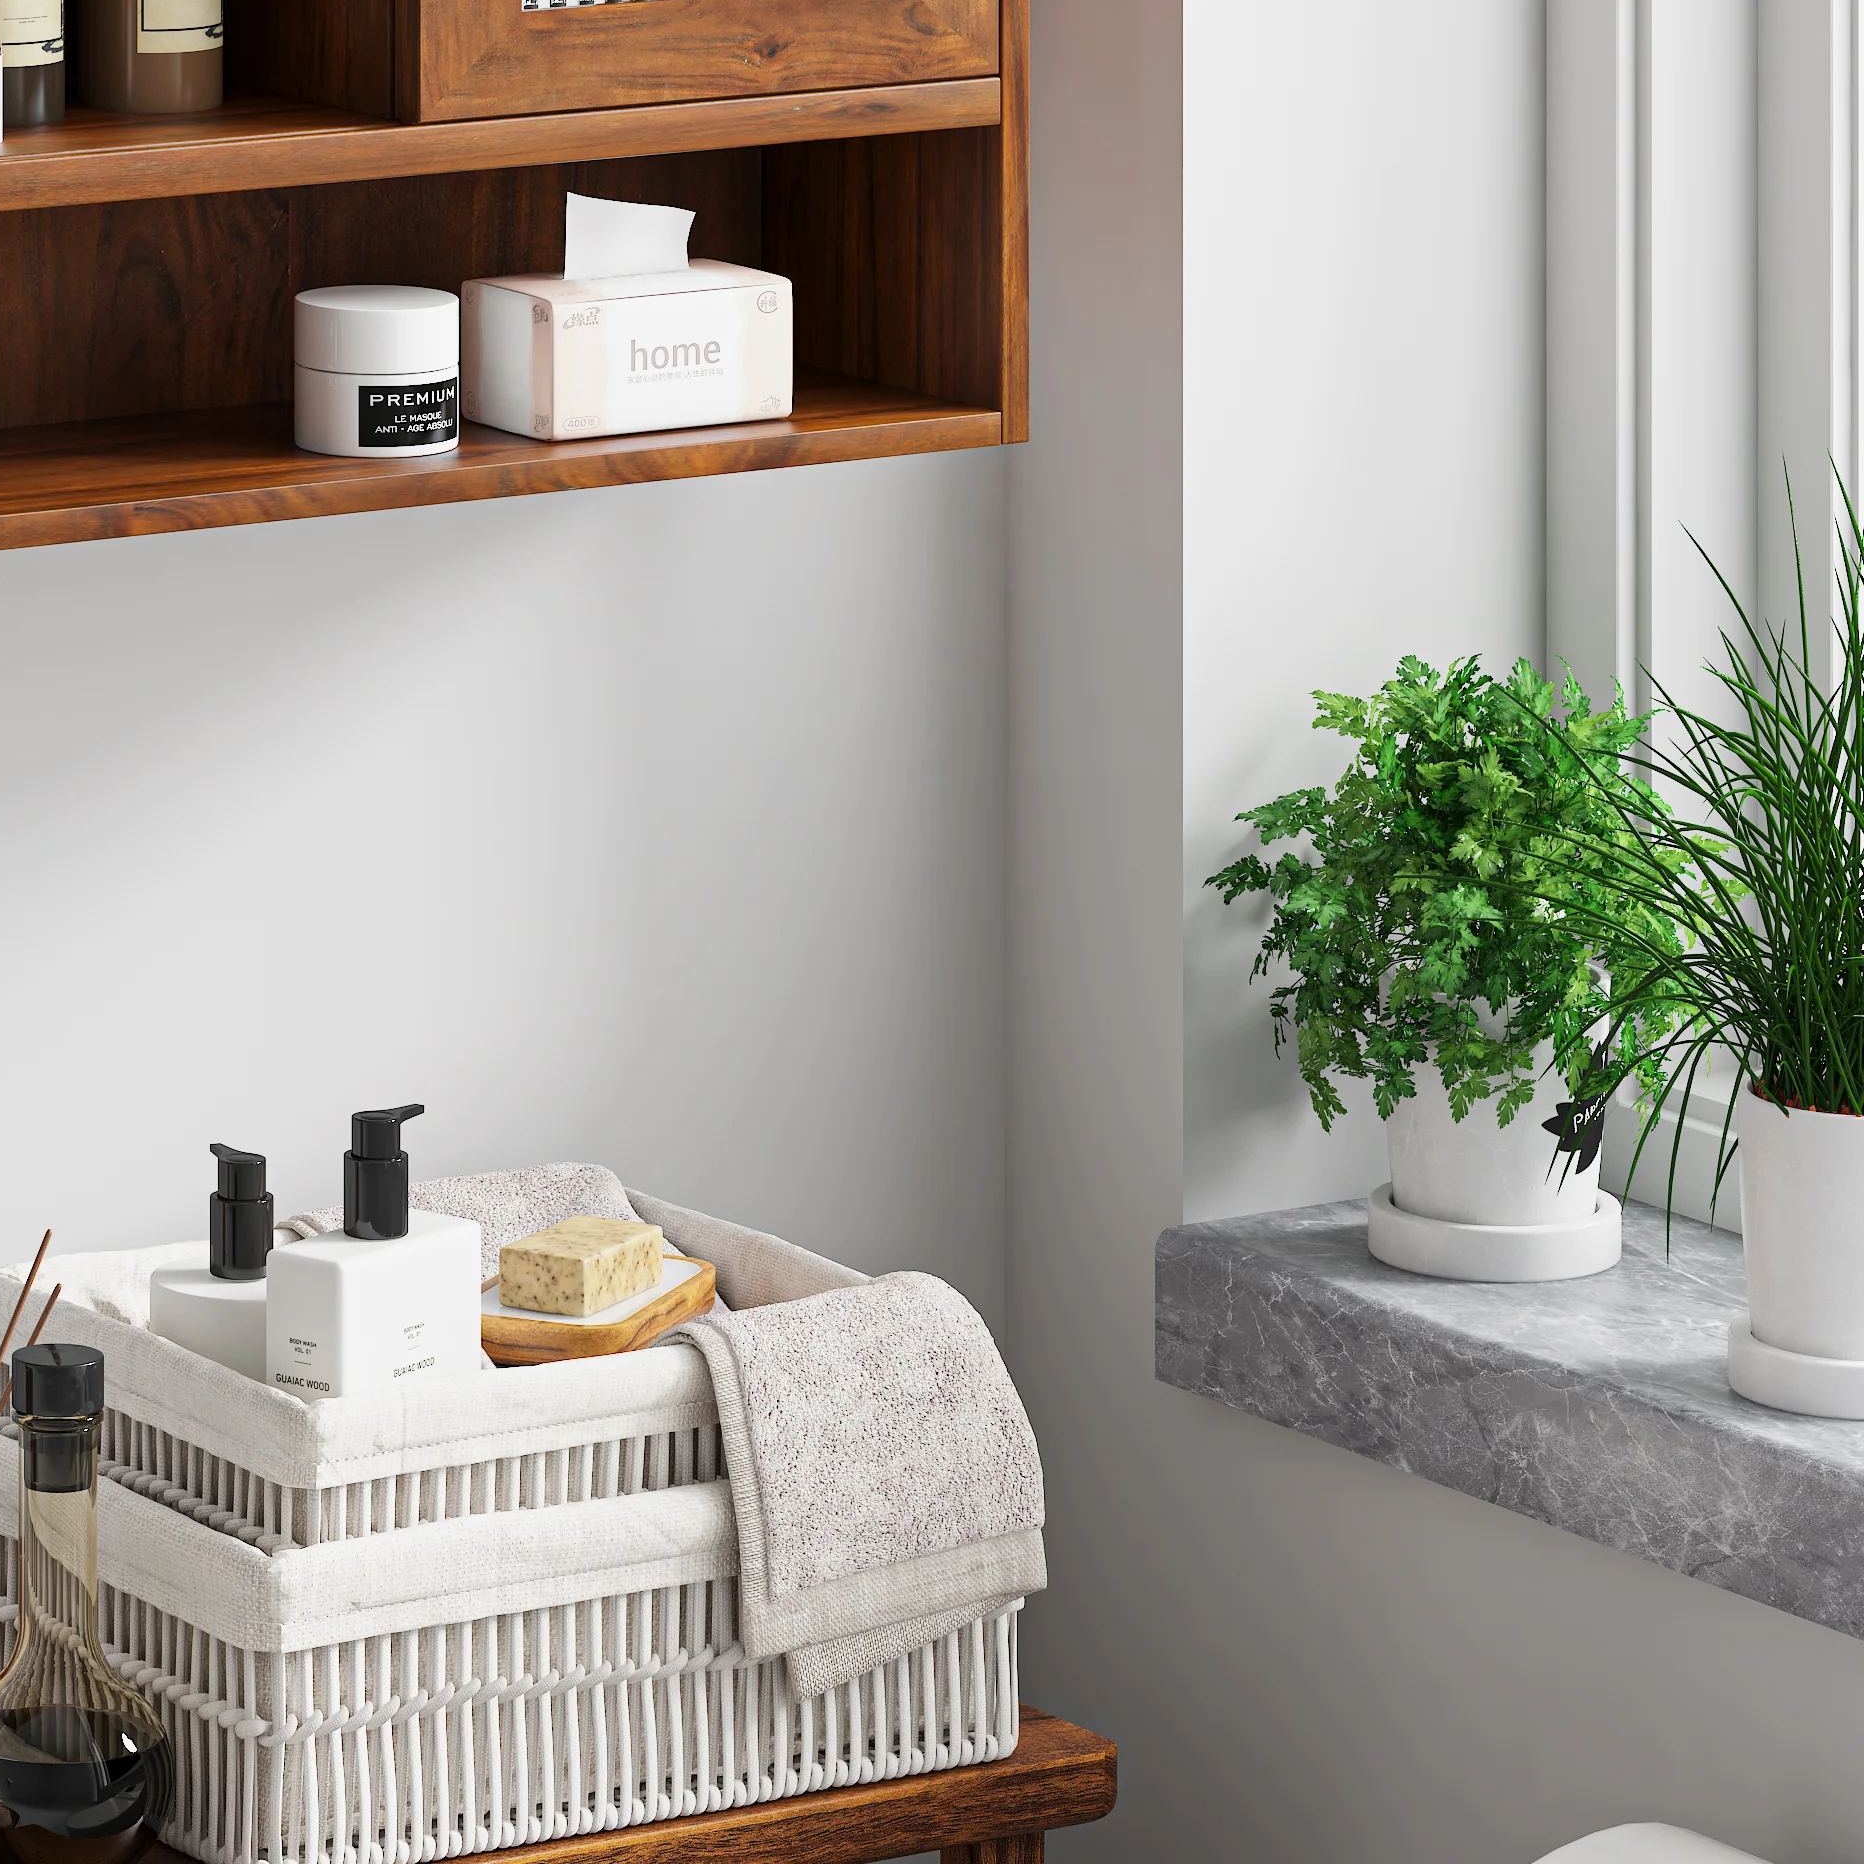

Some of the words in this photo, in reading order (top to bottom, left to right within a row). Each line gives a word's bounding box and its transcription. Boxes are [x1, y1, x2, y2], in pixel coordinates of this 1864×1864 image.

[631, 340, 721, 371] home
[370, 386, 454, 407] PREMIUM
[375, 425, 398, 433] ANTI
[407, 424, 425, 432] AGE
[426, 418, 453, 430] ABSOLU
[395, 415, 407, 423] LE
[410, 411, 442, 422] MASQUE
[290, 1337, 302, 1345] BODY
[394, 1363, 416, 1378] GUAIAC
[417, 1356, 434, 1369] WOOD
[276, 1373, 304, 1387] GUAIAC
[306, 1379, 329, 1391] WOOD
